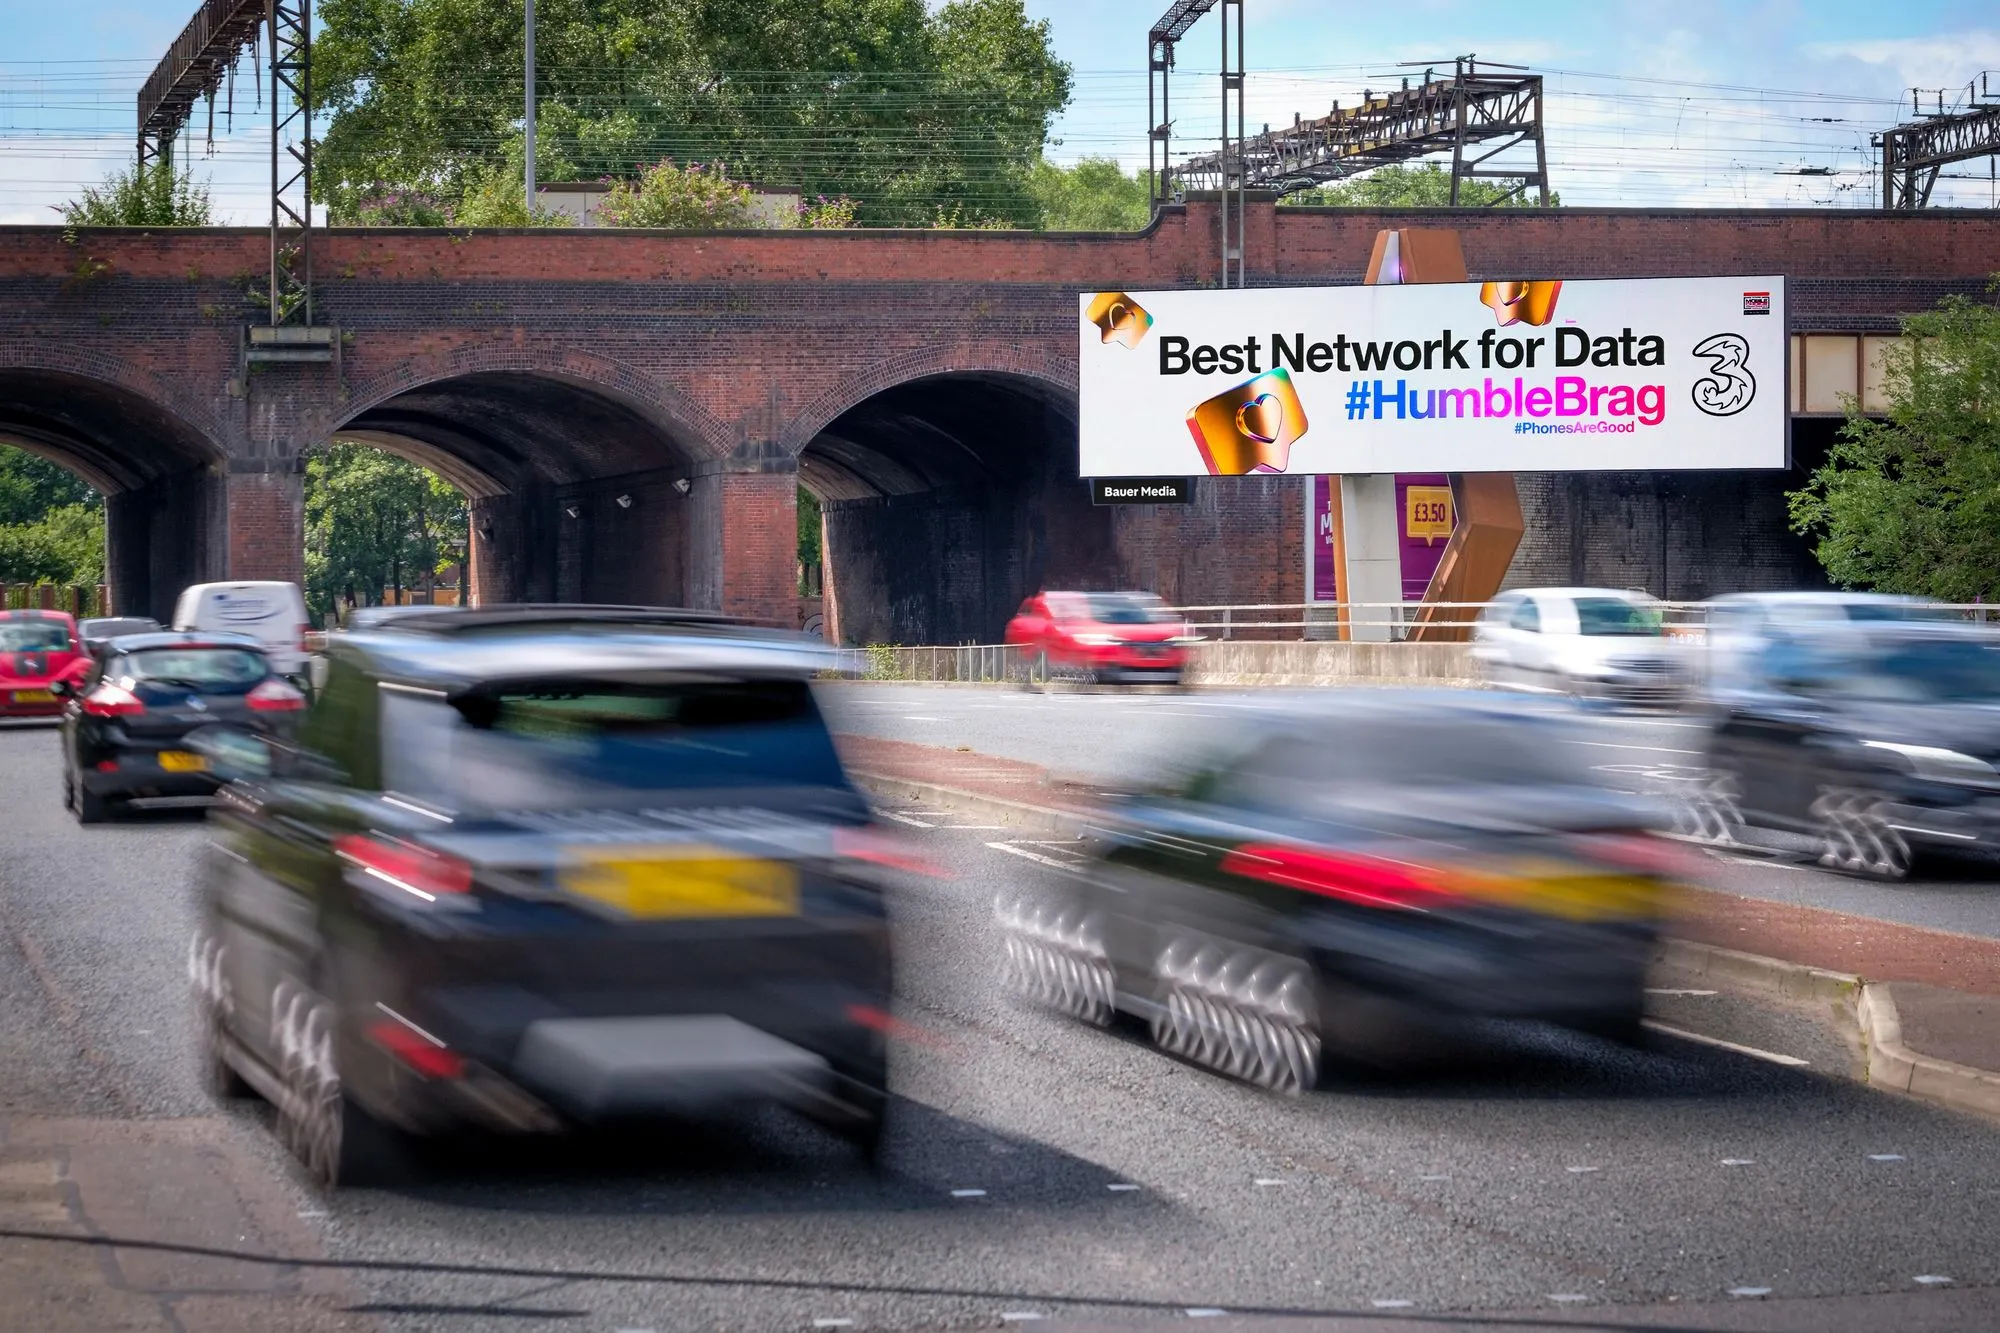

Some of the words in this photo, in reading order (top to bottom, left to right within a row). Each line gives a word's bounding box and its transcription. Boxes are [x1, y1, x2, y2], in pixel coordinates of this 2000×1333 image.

[1160, 336, 1261, 375] Best
[1272, 329, 1470, 373] Network
[1477, 328, 1545, 369] for
[1555, 327, 1665, 367] Data
[1345, 376, 1666, 425] #HumbleBrag
[1515, 421, 1635, 434] #PhonesAreGood
[1104, 487, 1138, 497] Bauer
[1141, 486, 1177, 497] Media
[1414, 502, 1446, 522] £3.50
